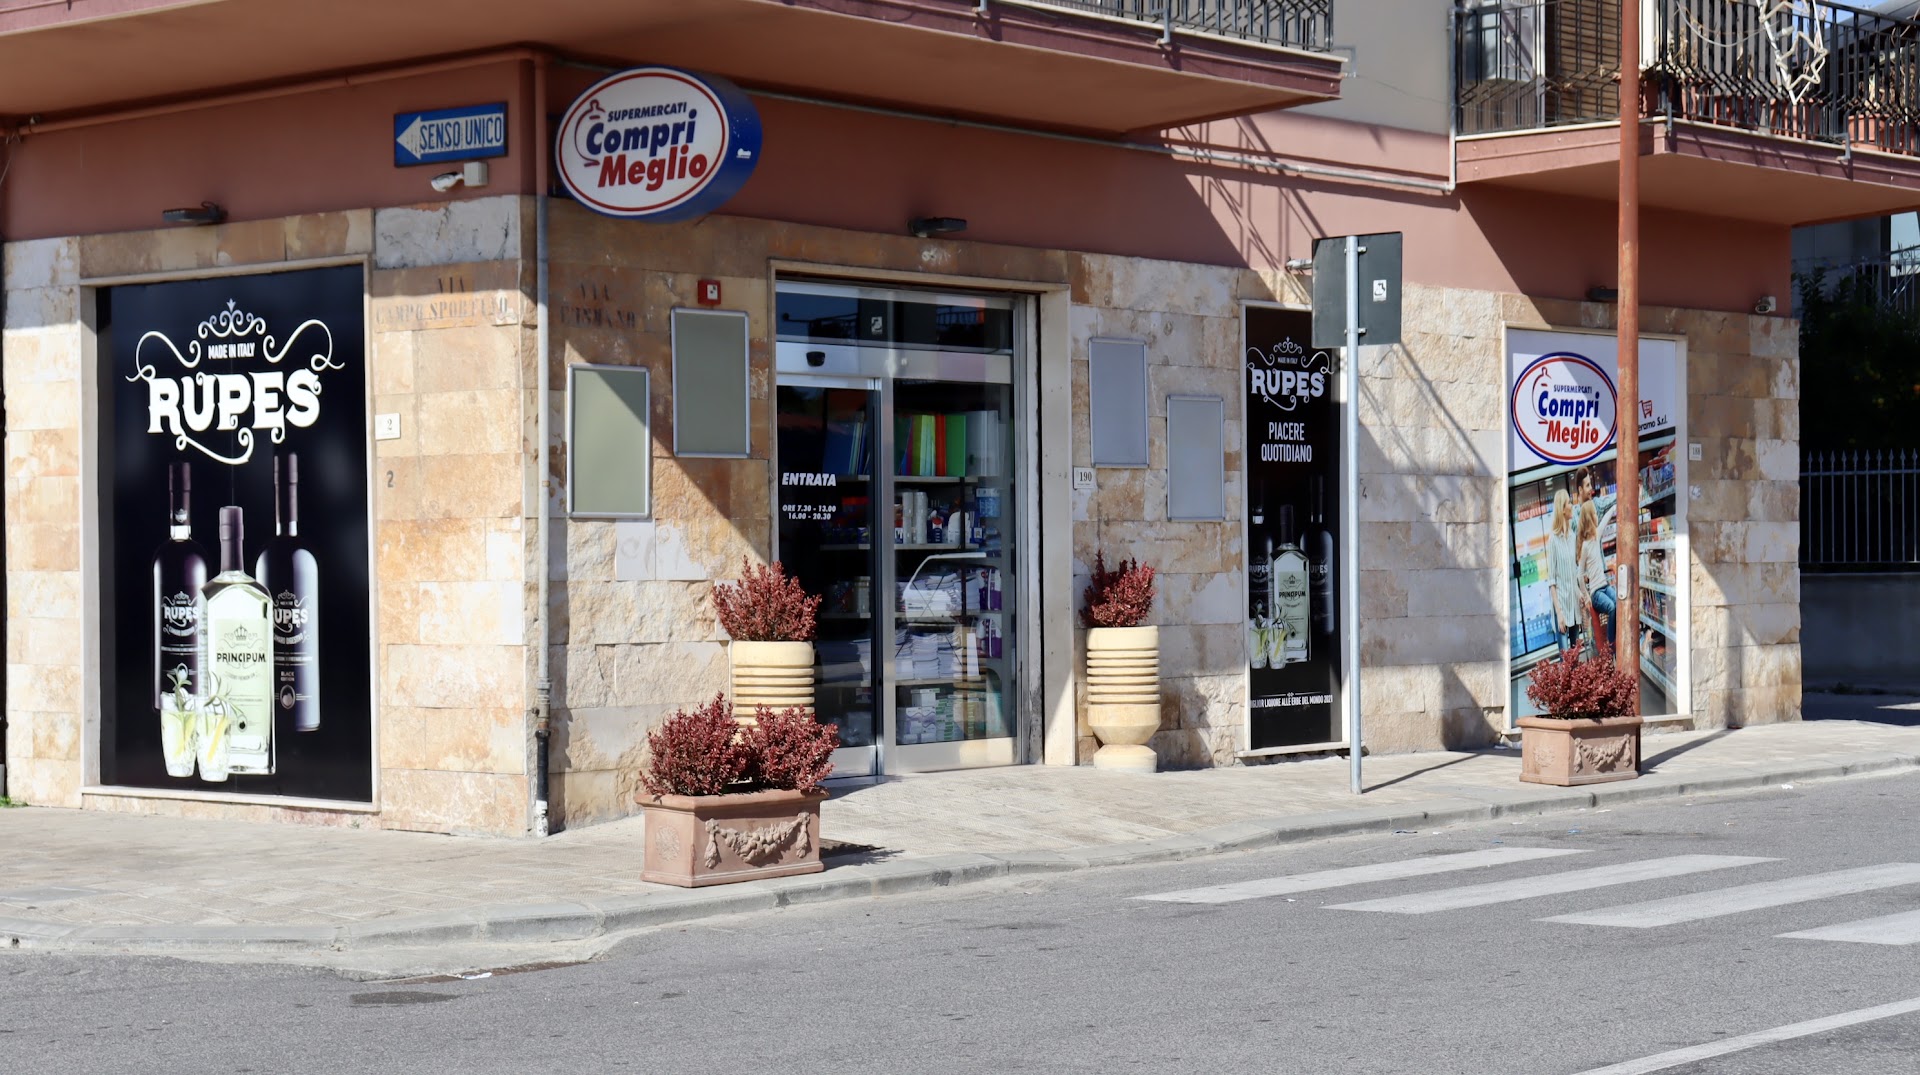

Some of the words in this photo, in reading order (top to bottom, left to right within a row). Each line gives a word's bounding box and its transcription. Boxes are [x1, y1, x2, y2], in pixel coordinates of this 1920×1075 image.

[607, 101, 688, 122] SUPERMERCATI
[419, 119, 462, 151] SENSO
[464, 113, 503, 147] UNICO
[586, 109, 697, 157] Compri
[598, 145, 708, 192] Meglio
[208, 345, 229, 359] MADE
[229, 344, 237, 358] IN
[237, 342, 255, 358] ITALY
[1277, 356, 1287, 364] MADE
[1251, 369, 1325, 411] RUPES
[1553, 384, 1593, 394] SUPERMERCATI
[147, 368, 322, 465] RUPES
[1538, 390, 1599, 425] Compri
[1268, 421, 1305, 441] PIACERE
[1546, 420, 1599, 450] Meglio
[1638, 421, 1656, 432] eramo
[1261, 443, 1312, 463] QUOTIDIANO
[386, 470, 394, 488] 2
[781, 472, 837, 487] ENTRATA
[1079, 472, 1092, 482] 190
[782, 504, 796, 512] ORE
[797, 504, 812, 512] 7.30
[818, 504, 837, 513] 13.00
[788, 512, 807, 520] 16.00
[812, 512, 832, 520] 20.30
[1310, 564, 1329, 573] UPES
[164, 606, 199, 624] RUPES
[274, 608, 309, 629] UPES
[216, 652, 266, 663] PRINCIPUM
